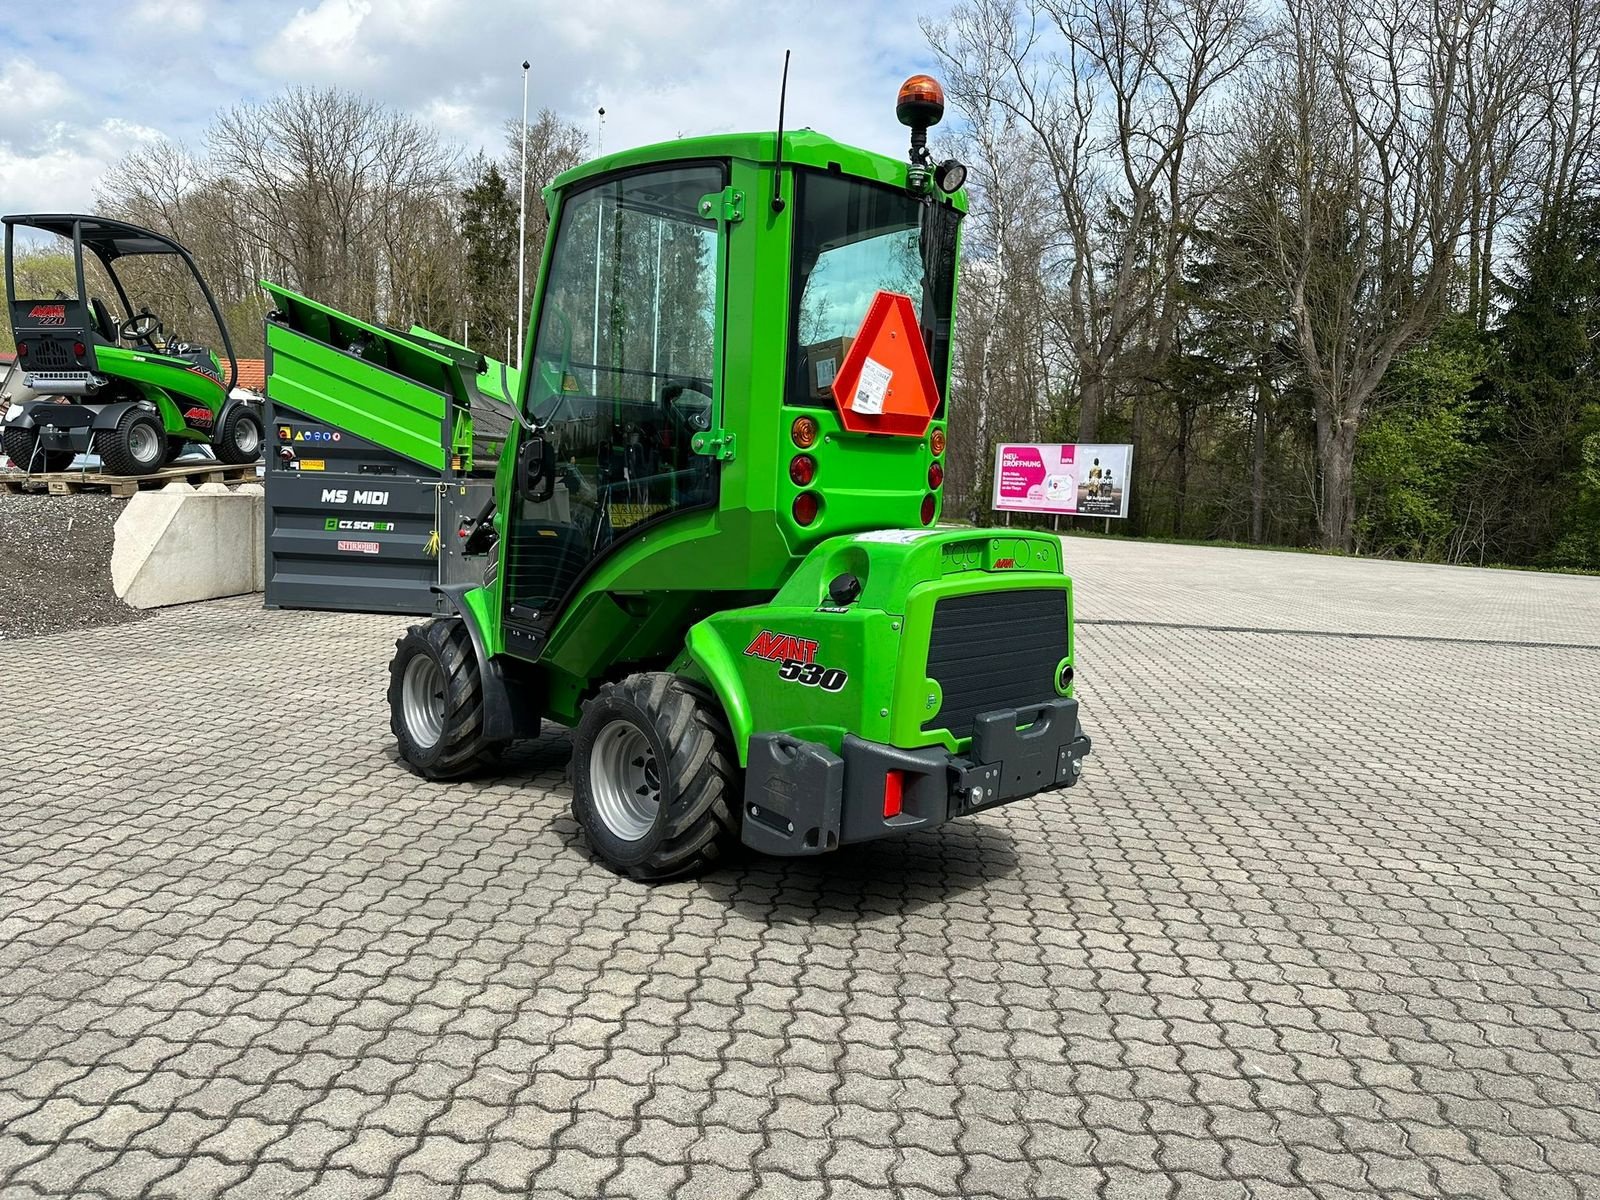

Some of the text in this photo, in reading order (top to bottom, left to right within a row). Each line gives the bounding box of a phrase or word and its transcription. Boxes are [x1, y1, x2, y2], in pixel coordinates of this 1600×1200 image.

[28, 304, 66, 318] AVANT
[38, 316, 67, 326] 220
[1003, 453, 1019, 461] NEU-
[1003, 459, 1041, 468] ERÖFFNUNG
[321, 489, 389, 505] MS MIDI
[743, 629, 820, 664] AVANT
[778, 659, 849, 693] 530
